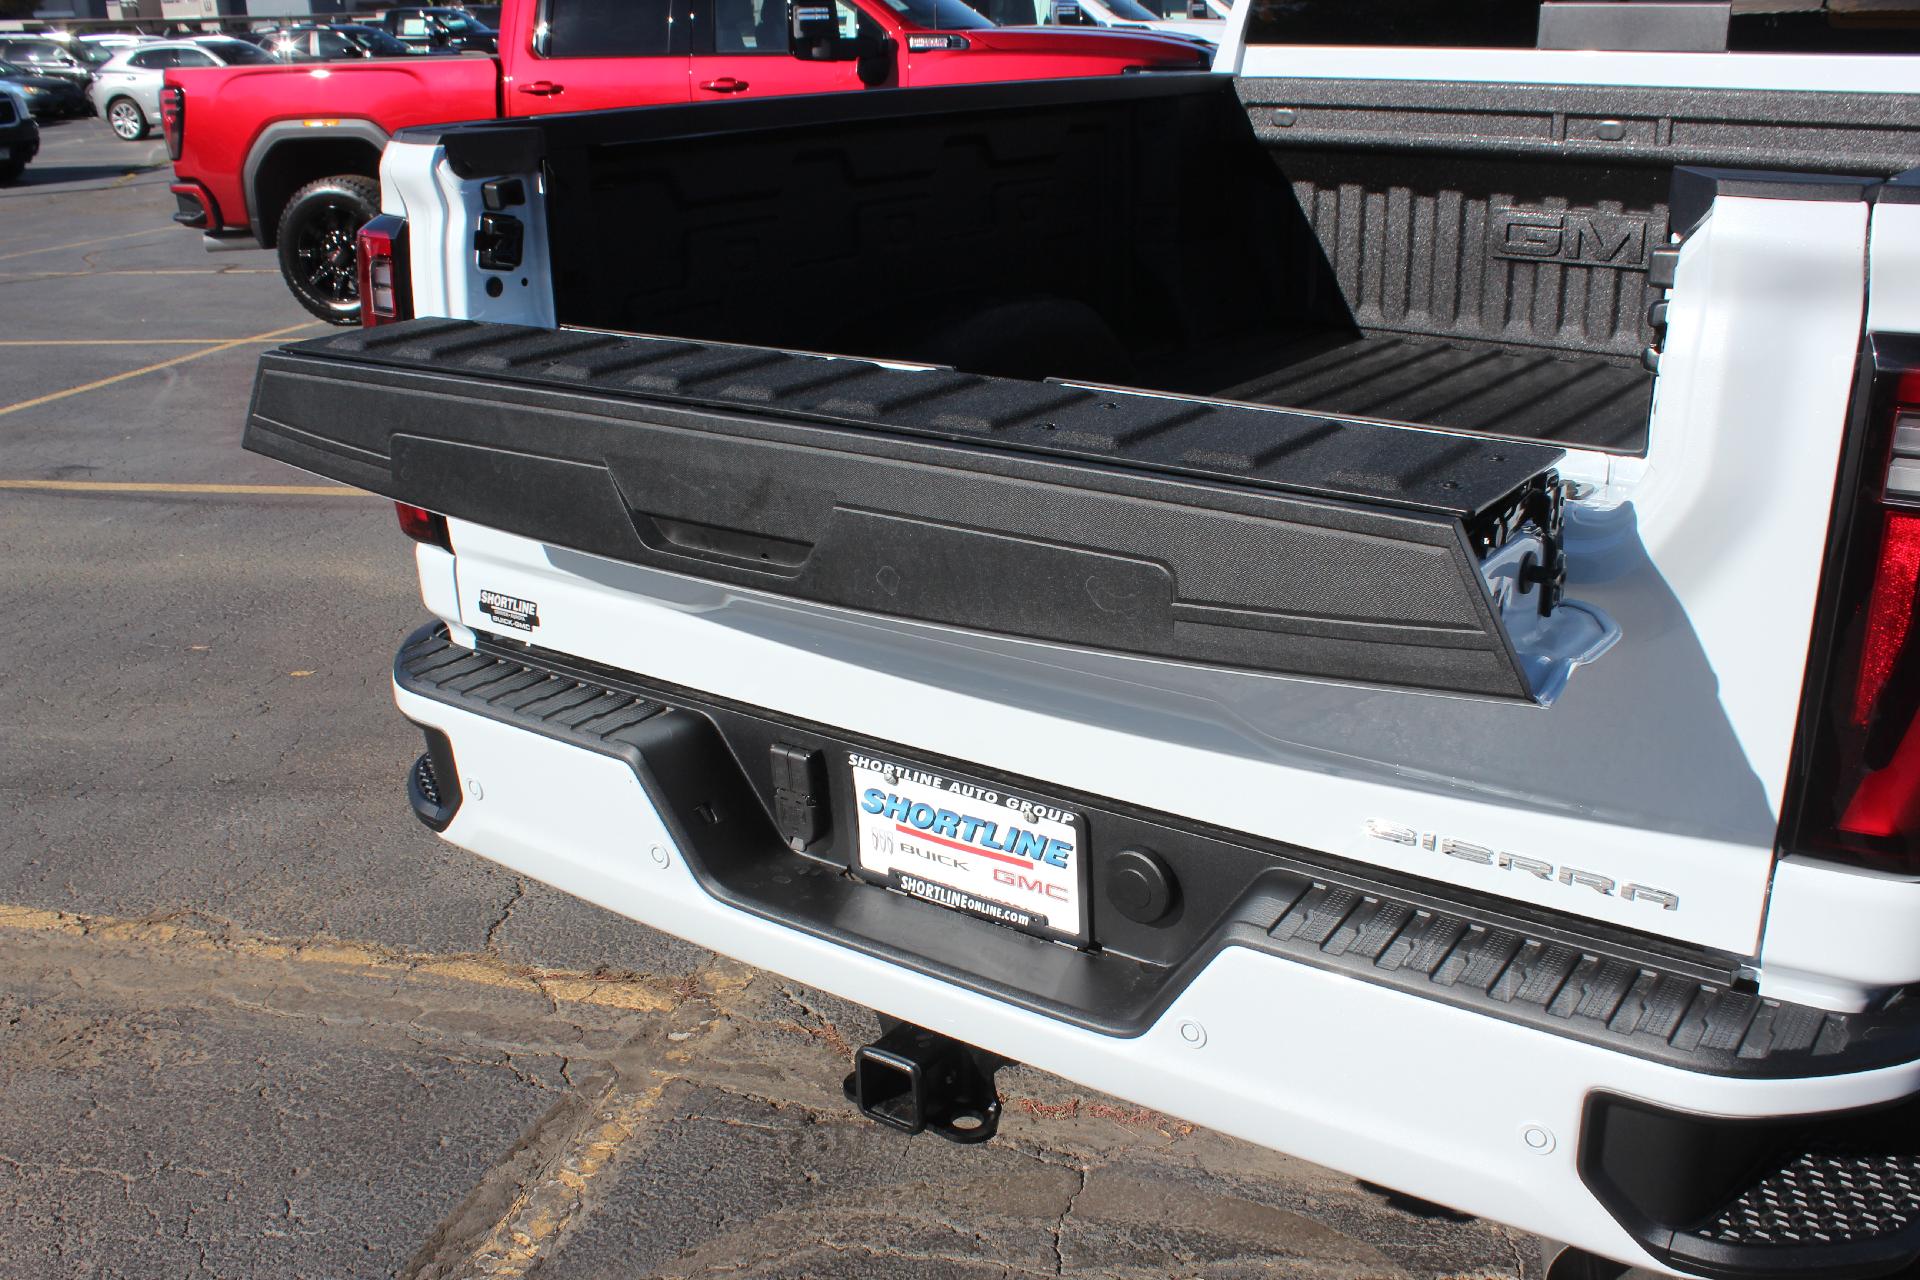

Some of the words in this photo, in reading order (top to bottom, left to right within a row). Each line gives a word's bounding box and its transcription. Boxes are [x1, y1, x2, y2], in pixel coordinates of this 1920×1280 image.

[481, 591, 536, 616] SHORTLINE
[848, 753, 943, 789] SHORTLINE
[949, 781, 998, 805] AUTO
[1006, 797, 1075, 824] GROUP
[861, 788, 1074, 869] SHORTLINE
[899, 842, 971, 872] BUICK
[1365, 817, 1679, 911] SIERRA
[993, 868, 1069, 903] GMC
